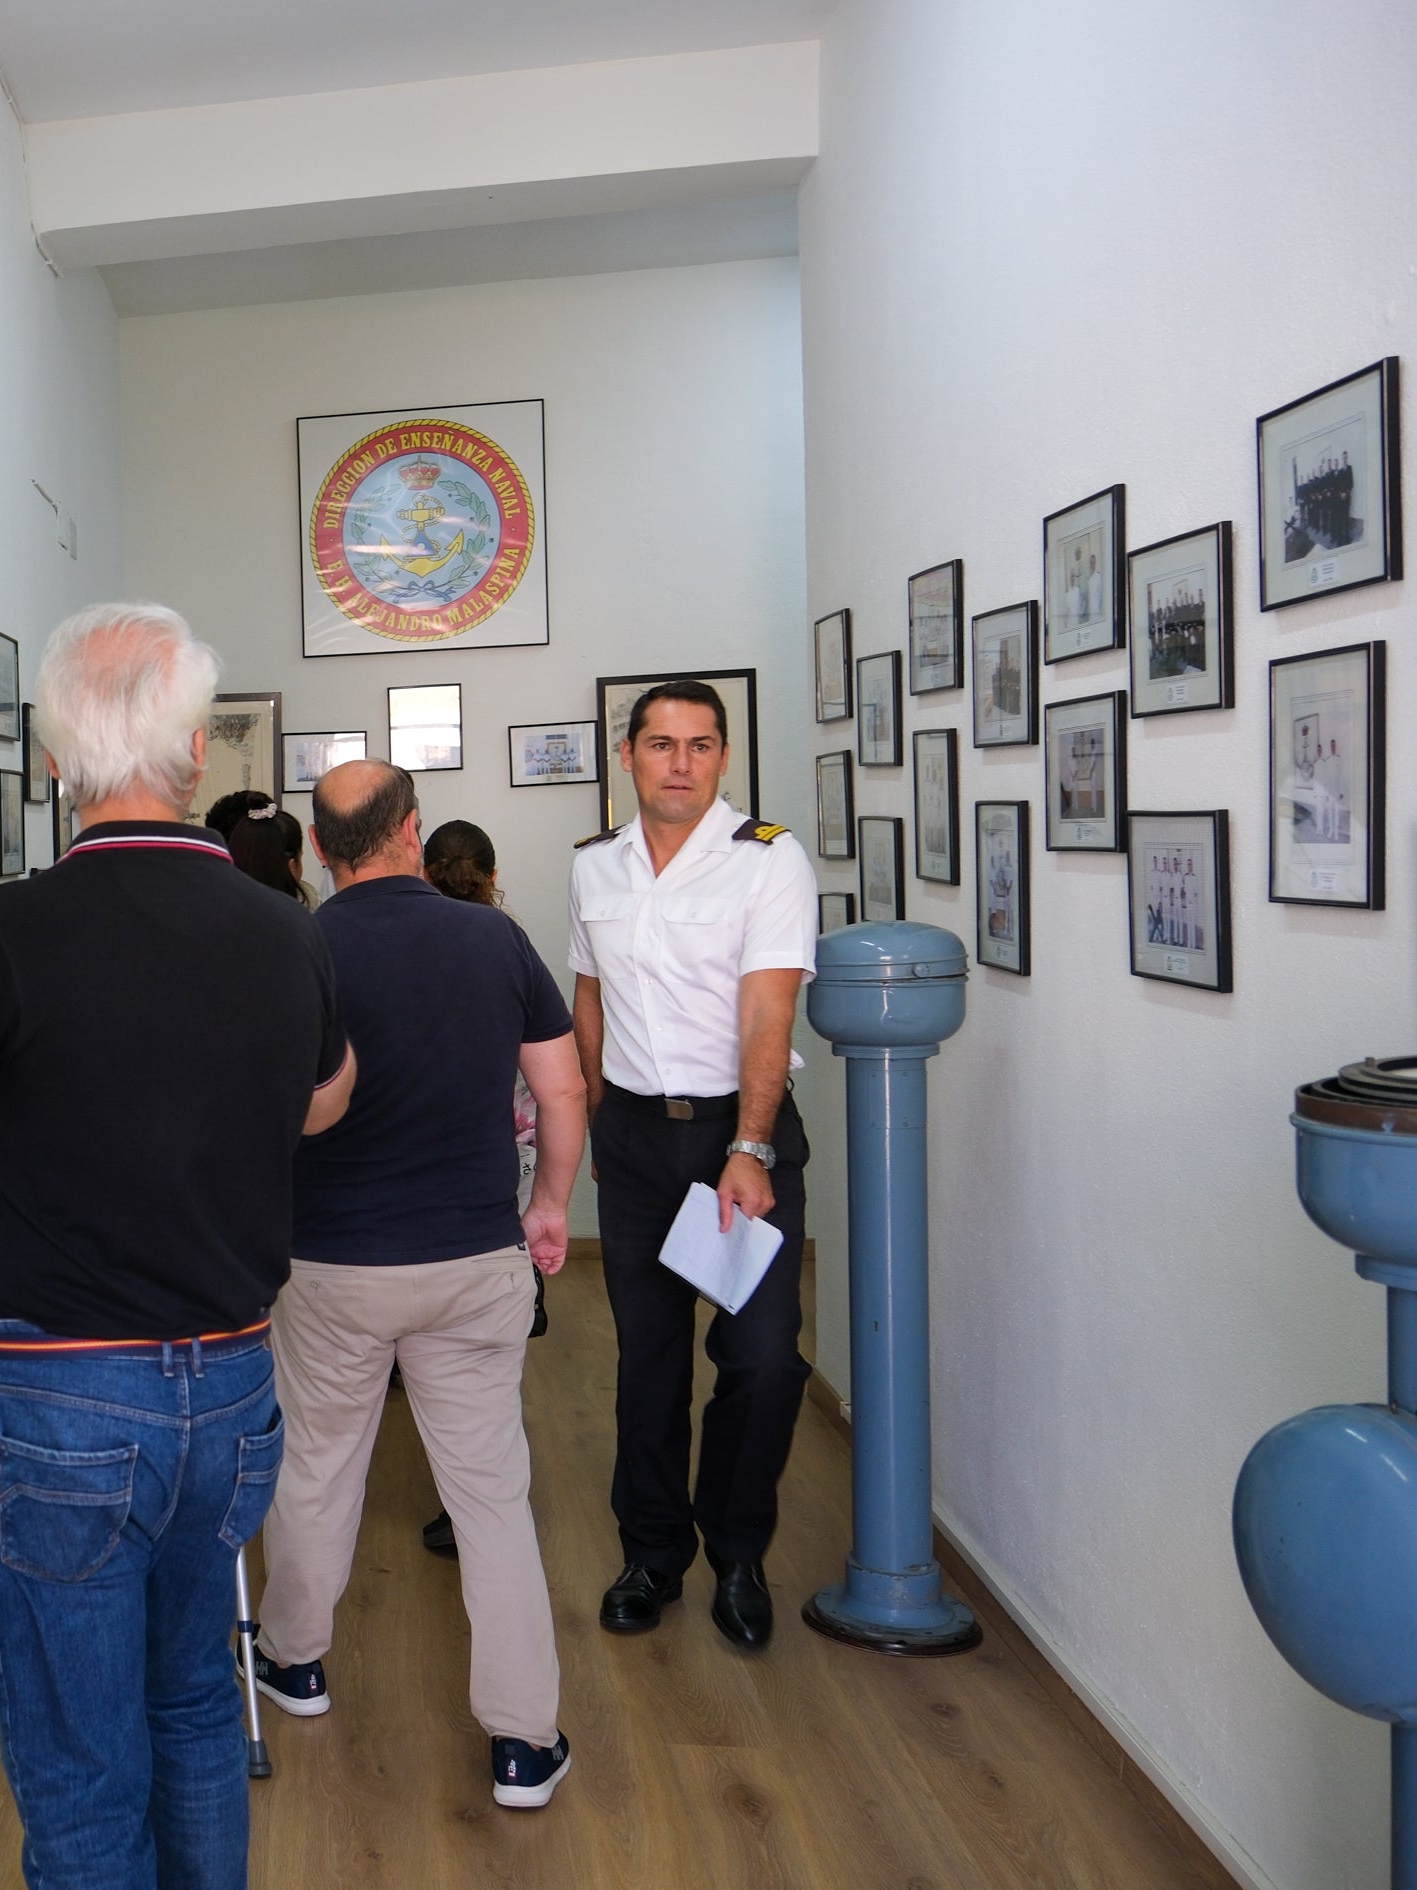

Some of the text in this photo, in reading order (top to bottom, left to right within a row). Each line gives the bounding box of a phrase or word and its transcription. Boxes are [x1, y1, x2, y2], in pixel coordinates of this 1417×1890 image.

[323, 430, 520, 528] DIRECCION DE ENSEÑANZA NAVAL
[345, 592, 442, 630] ALEJANDRO
[446, 548, 520, 625] MALASPINA
